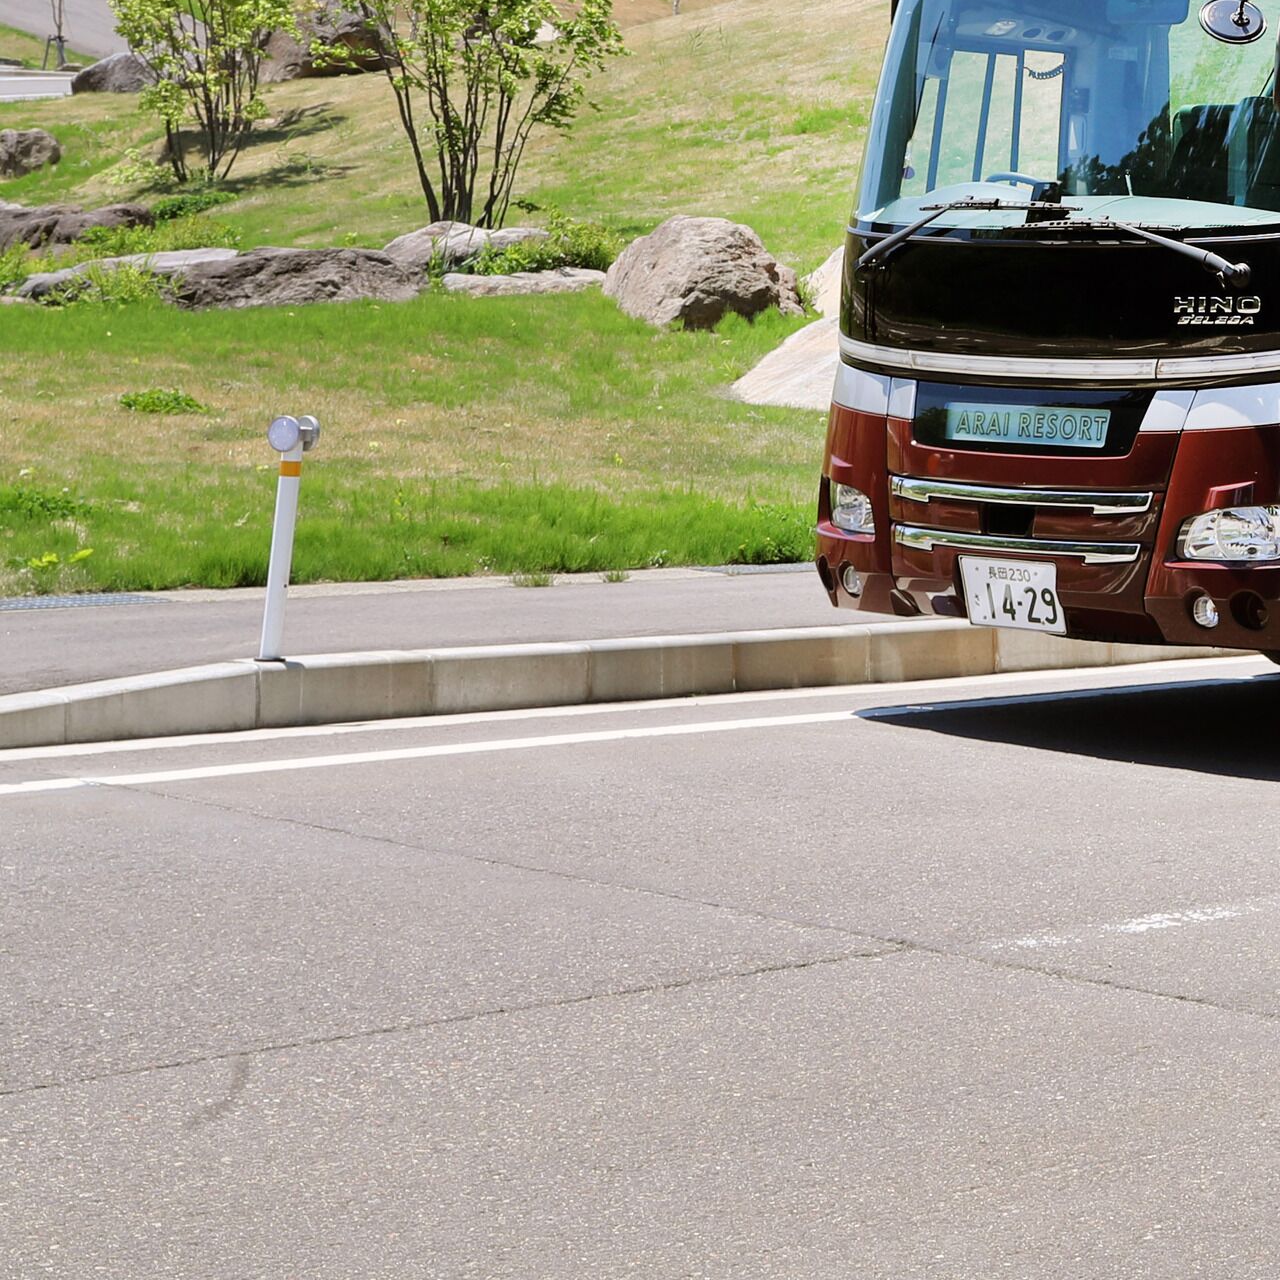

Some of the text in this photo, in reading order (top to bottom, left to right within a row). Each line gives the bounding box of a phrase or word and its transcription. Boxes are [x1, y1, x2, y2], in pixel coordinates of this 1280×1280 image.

[1173, 296, 1261, 314] HINO
[955, 410, 1108, 441] ARAI RESORT
[986, 582, 1058, 625] 14-29
